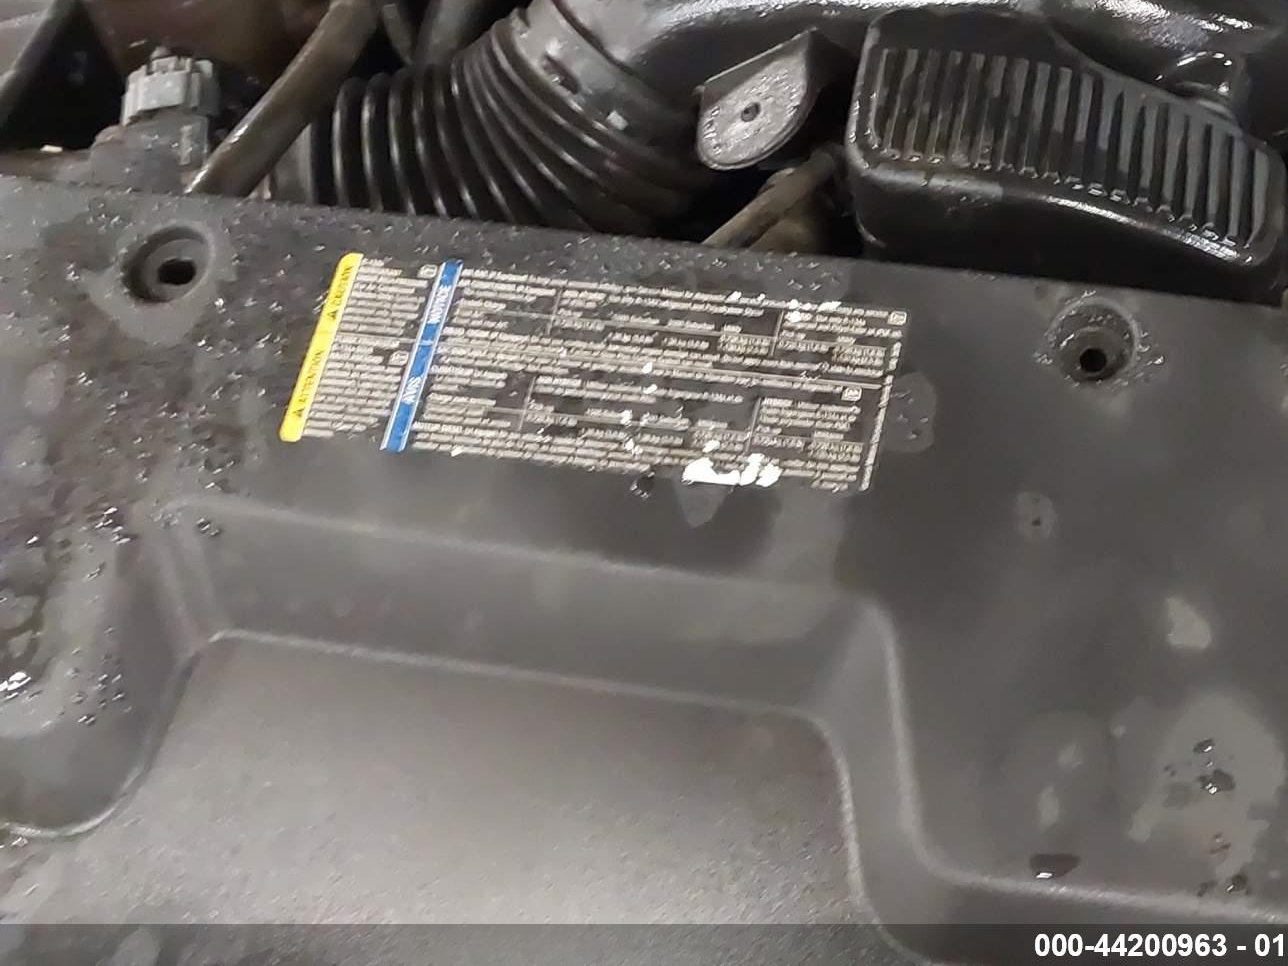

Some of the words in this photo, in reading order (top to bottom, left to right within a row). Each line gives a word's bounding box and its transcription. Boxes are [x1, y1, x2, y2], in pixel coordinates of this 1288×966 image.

[427, 283, 451, 324] NOTICE
[297, 348, 325, 403] ATTENTION
[401, 376, 423, 405] AVIS
